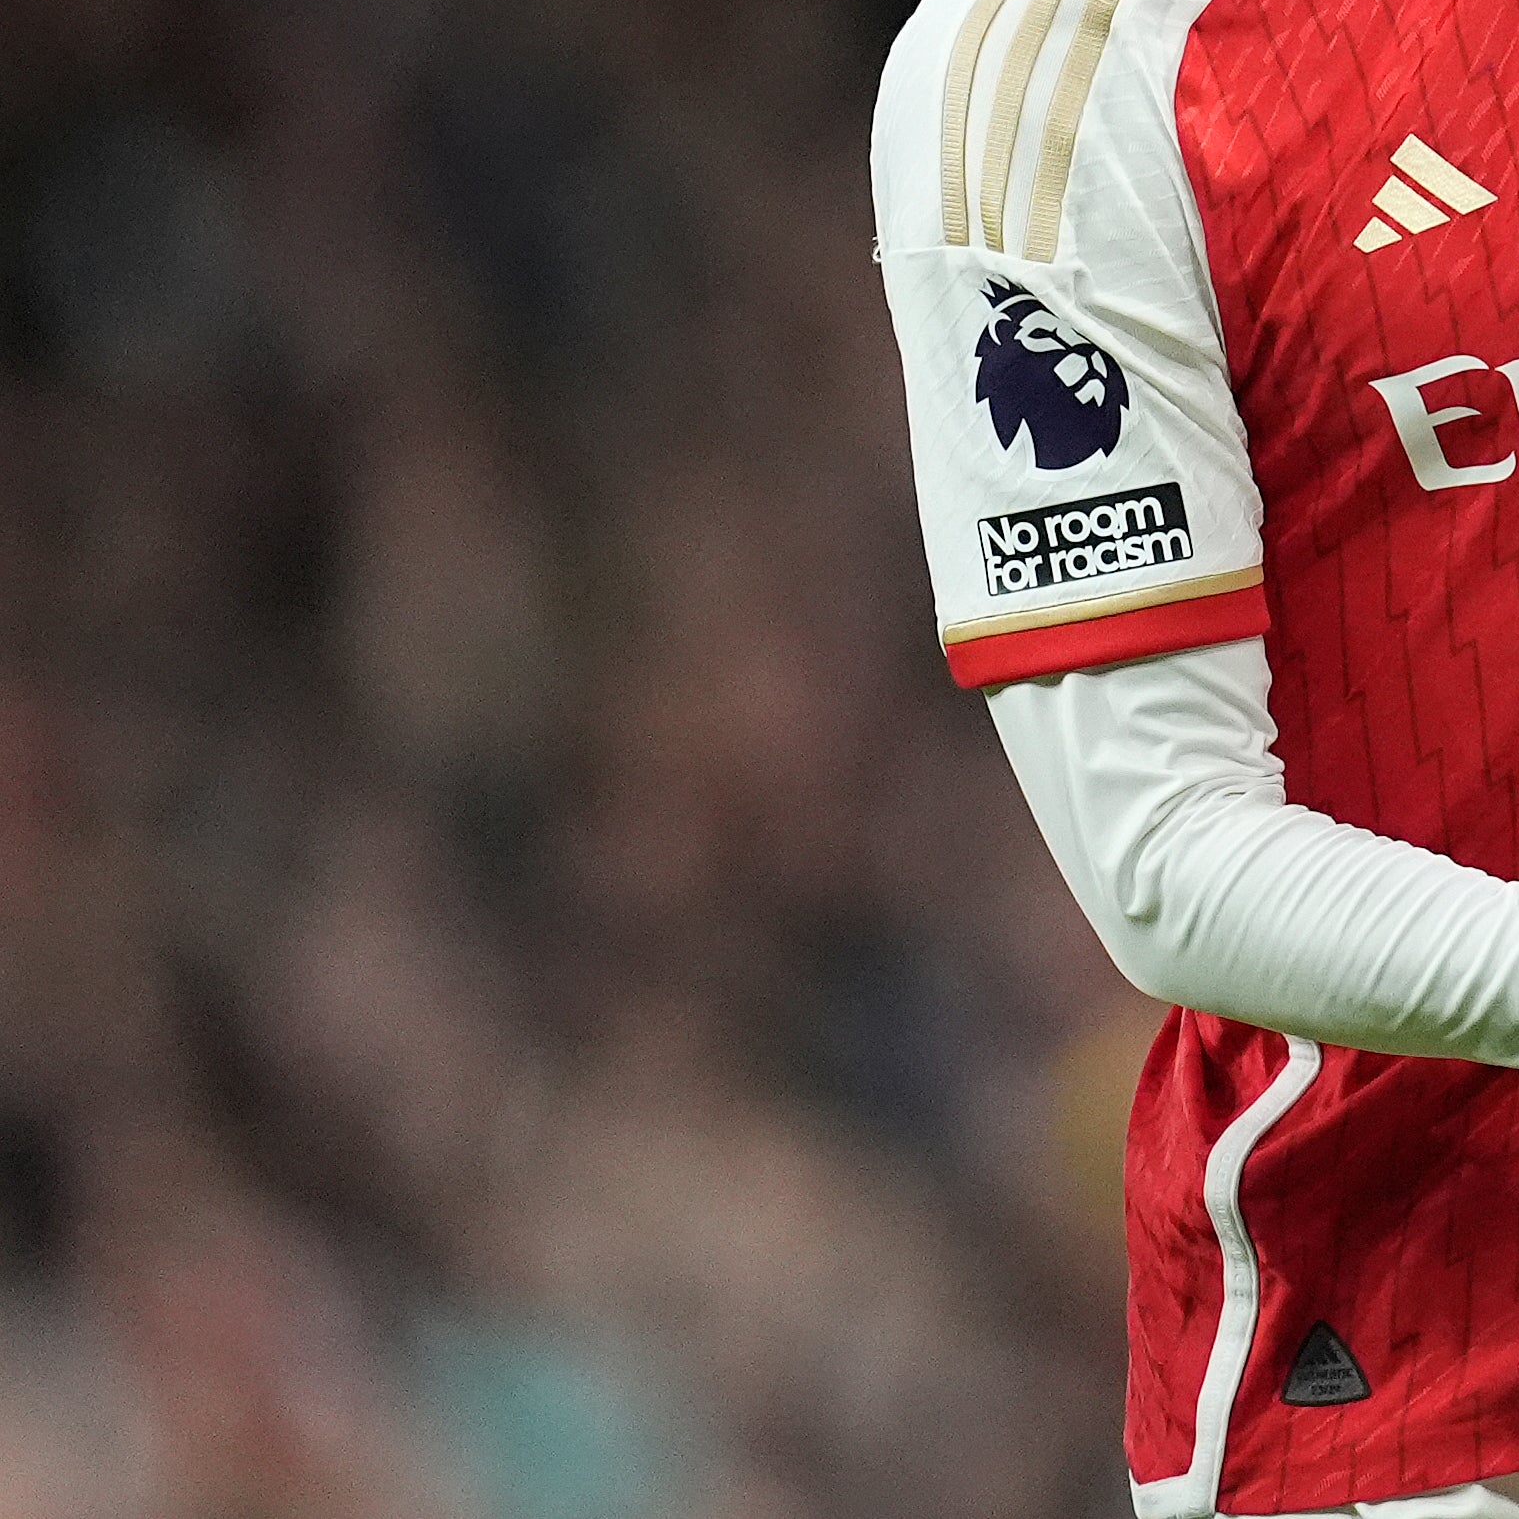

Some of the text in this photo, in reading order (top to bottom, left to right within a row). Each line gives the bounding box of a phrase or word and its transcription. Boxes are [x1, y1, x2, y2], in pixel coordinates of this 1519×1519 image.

[979, 496, 1165, 560] No room
[985, 527, 1192, 595] for racism
